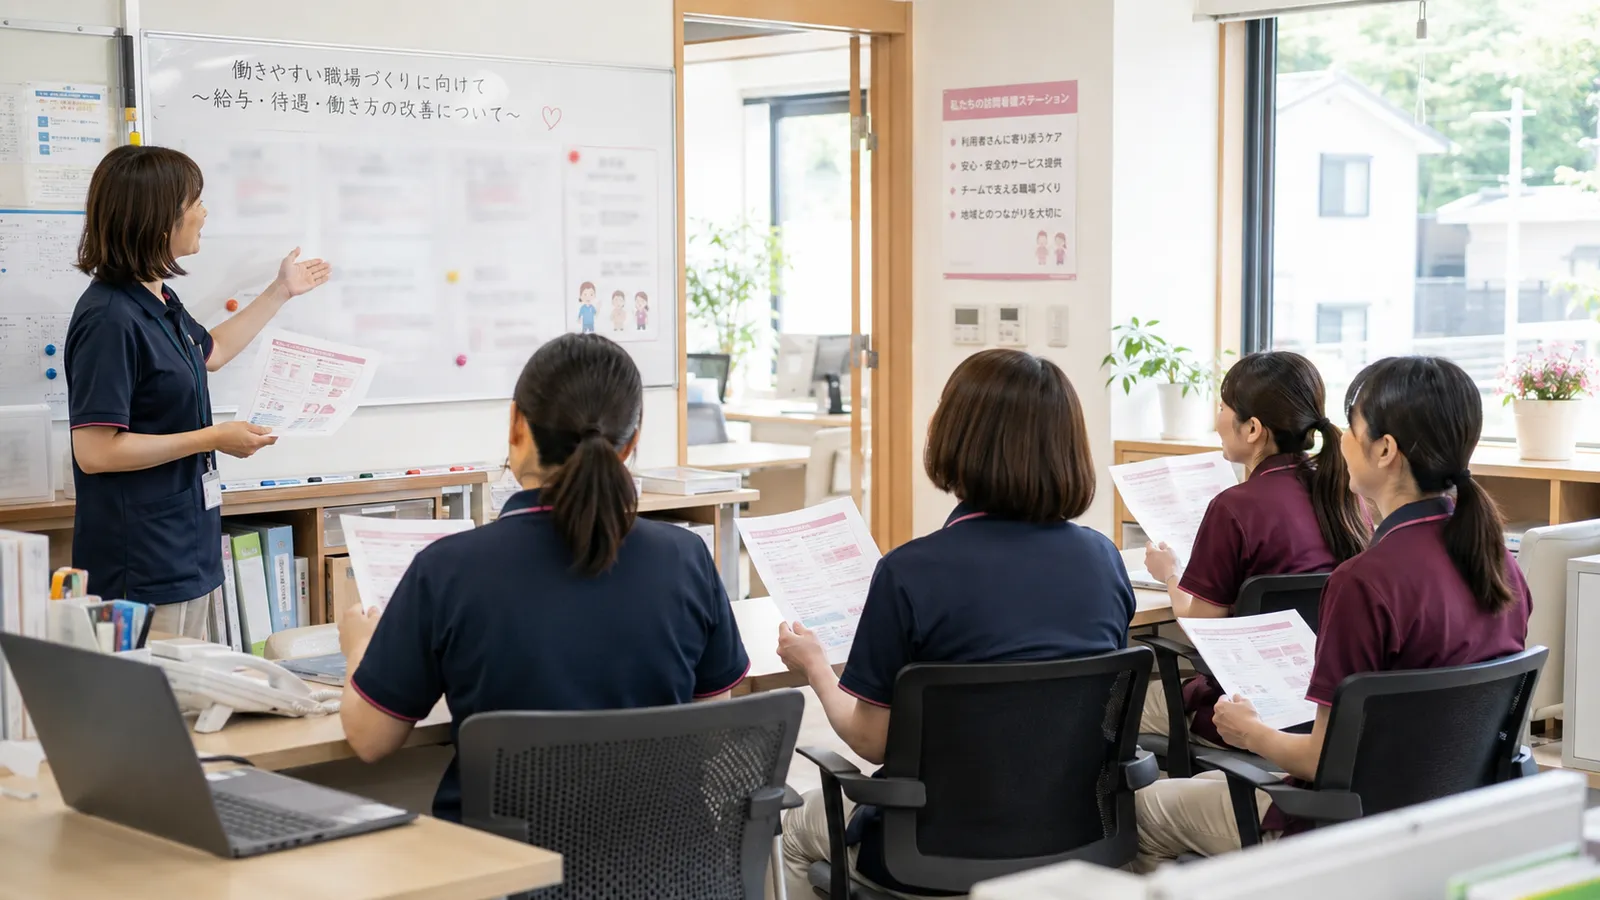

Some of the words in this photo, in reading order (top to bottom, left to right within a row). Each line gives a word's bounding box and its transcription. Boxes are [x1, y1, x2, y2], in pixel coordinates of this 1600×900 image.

[231, 60, 485, 94] 働きやすい職場づくりに向けて
[961, 132, 1062, 147] 利用者さんに寄り添うケア
[961, 157, 1062, 172] 安心・安全のサービス提供
[961, 182, 1061, 196] チームで支える職場づくり
[960, 208, 1062, 221] 地域とのつながりを大切に
